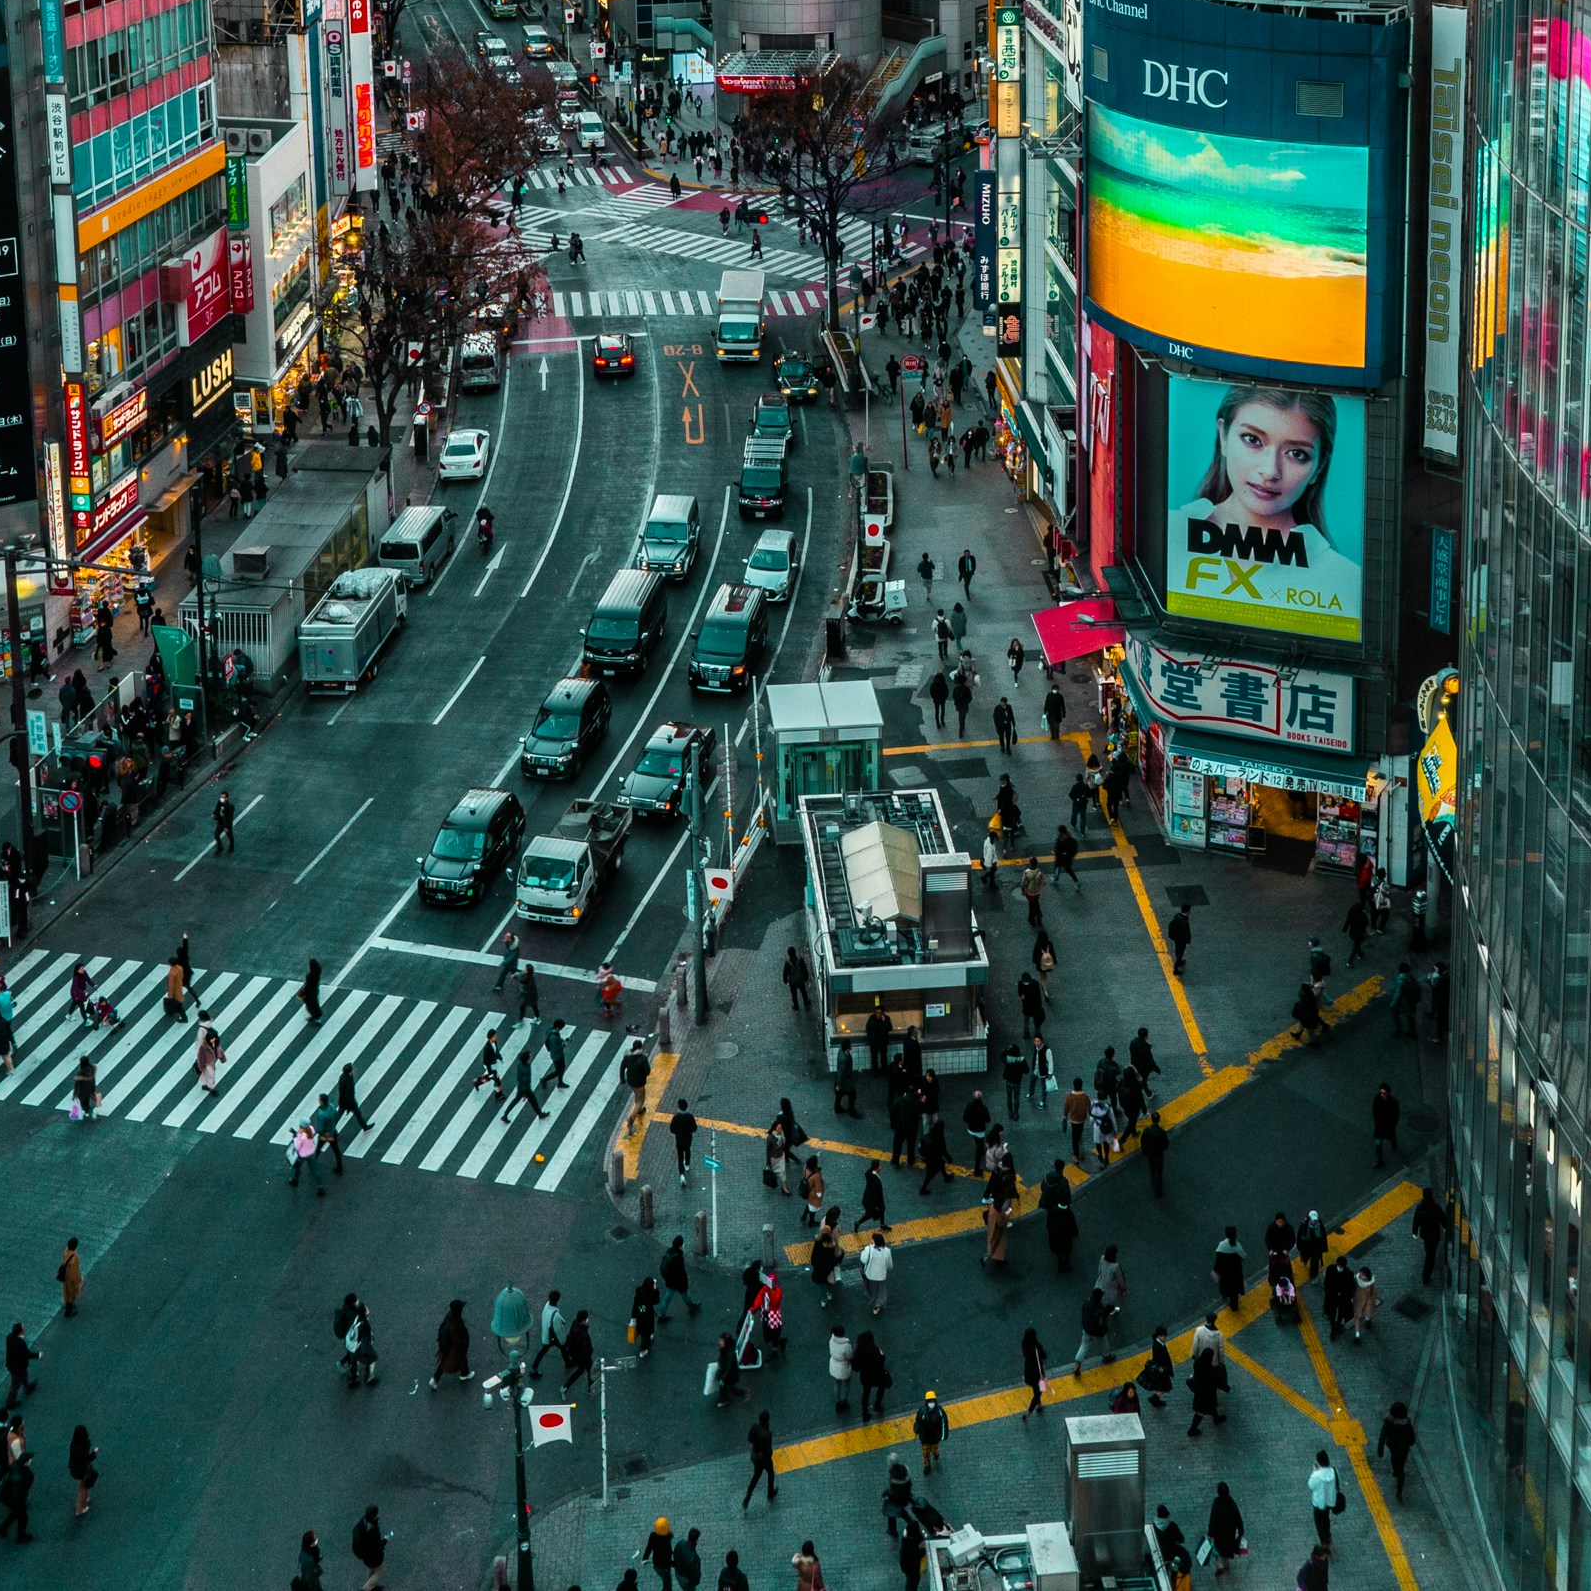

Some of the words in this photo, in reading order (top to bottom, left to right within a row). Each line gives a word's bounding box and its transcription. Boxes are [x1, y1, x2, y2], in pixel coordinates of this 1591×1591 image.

[1143, 59, 1228, 108] DHC
[51, 102, 66, 177] 渋谷駅前ビル
[334, 130, 345, 180] 処方せん受付
[1432, 58, 1462, 210] Taisei
[228, 159, 238, 186] レイク
[229, 187, 238, 221] ALSA
[982, 183, 991, 225] MIZUHO
[194, 271, 221, 309] アコム
[234, 270, 244, 299] アコム
[980, 256, 989, 300] みずほ銀行
[1428, 221, 1452, 343] neon
[205, 307, 213, 325] 3F
[1169, 342, 1193, 360] DHC
[191, 348, 233, 407] LUSH
[1187, 517, 1309, 569] DMM
[1186, 556, 1263, 599] FX
[1286, 587, 1343, 611] ROLA
[1287, 732, 1310, 742] BOOKS
[1314, 736, 1347, 749] TAISEIDO
[1239, 760, 1293, 775] TAISEIDO
